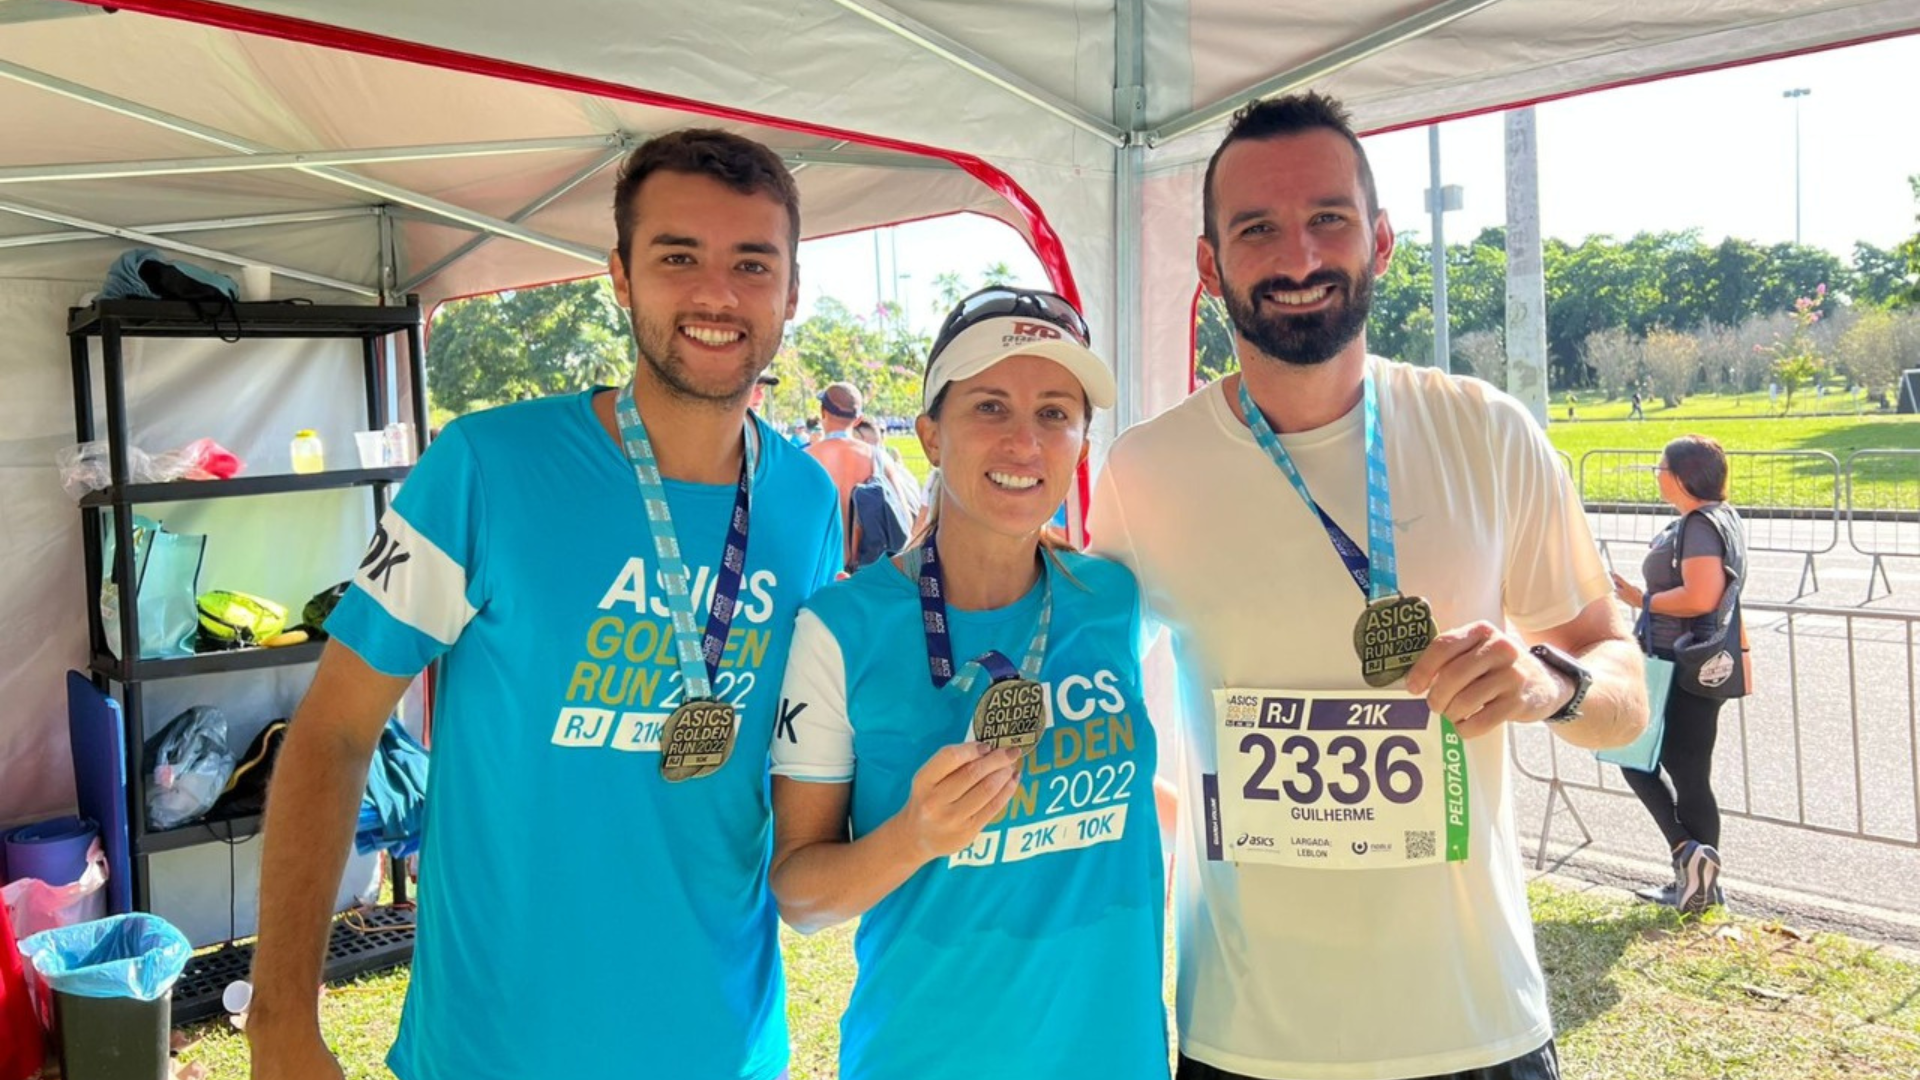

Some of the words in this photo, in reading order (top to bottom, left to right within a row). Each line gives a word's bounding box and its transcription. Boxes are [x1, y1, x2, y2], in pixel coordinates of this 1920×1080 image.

[1366, 602, 1427, 632] ASICS
[586, 616, 771, 669] GOLEN
[1365, 620, 1428, 646] GOLDEN
[1365, 642, 1394, 660] RUN
[1396, 635, 1429, 653] 2022
[565, 661, 662, 707] RUN
[659, 670, 756, 708] 222
[988, 684, 1041, 710] ASICS
[1227, 695, 1258, 707] ASICS
[677, 708, 733, 728] ASICS
[986, 704, 1041, 725] GOLDEN
[1266, 702, 1297, 724] RJ
[1346, 704, 1392, 725] 21K
[564, 714, 604, 739] RJ
[631, 722, 664, 744] 21K
[673, 726, 731, 742] GOLDEN
[983, 722, 1009, 739] RUN
[1010, 718, 1039, 734] 2022
[1445, 733, 1459, 745] B
[669, 741, 697, 755] RUN
[697, 740, 727, 753] 2022
[1239, 732, 1424, 806] 2336
[1045, 761, 1137, 815] 2022
[1443, 749, 1465, 826] PELOTÃO
[1291, 807, 1375, 821] GUILHERME
[1020, 825, 1059, 853] 21K
[1077, 812, 1116, 840] 10K
[1249, 836, 1275, 847] asics
[1290, 837, 1332, 847] LARGADA:
[1297, 849, 1328, 858] LEBLON
